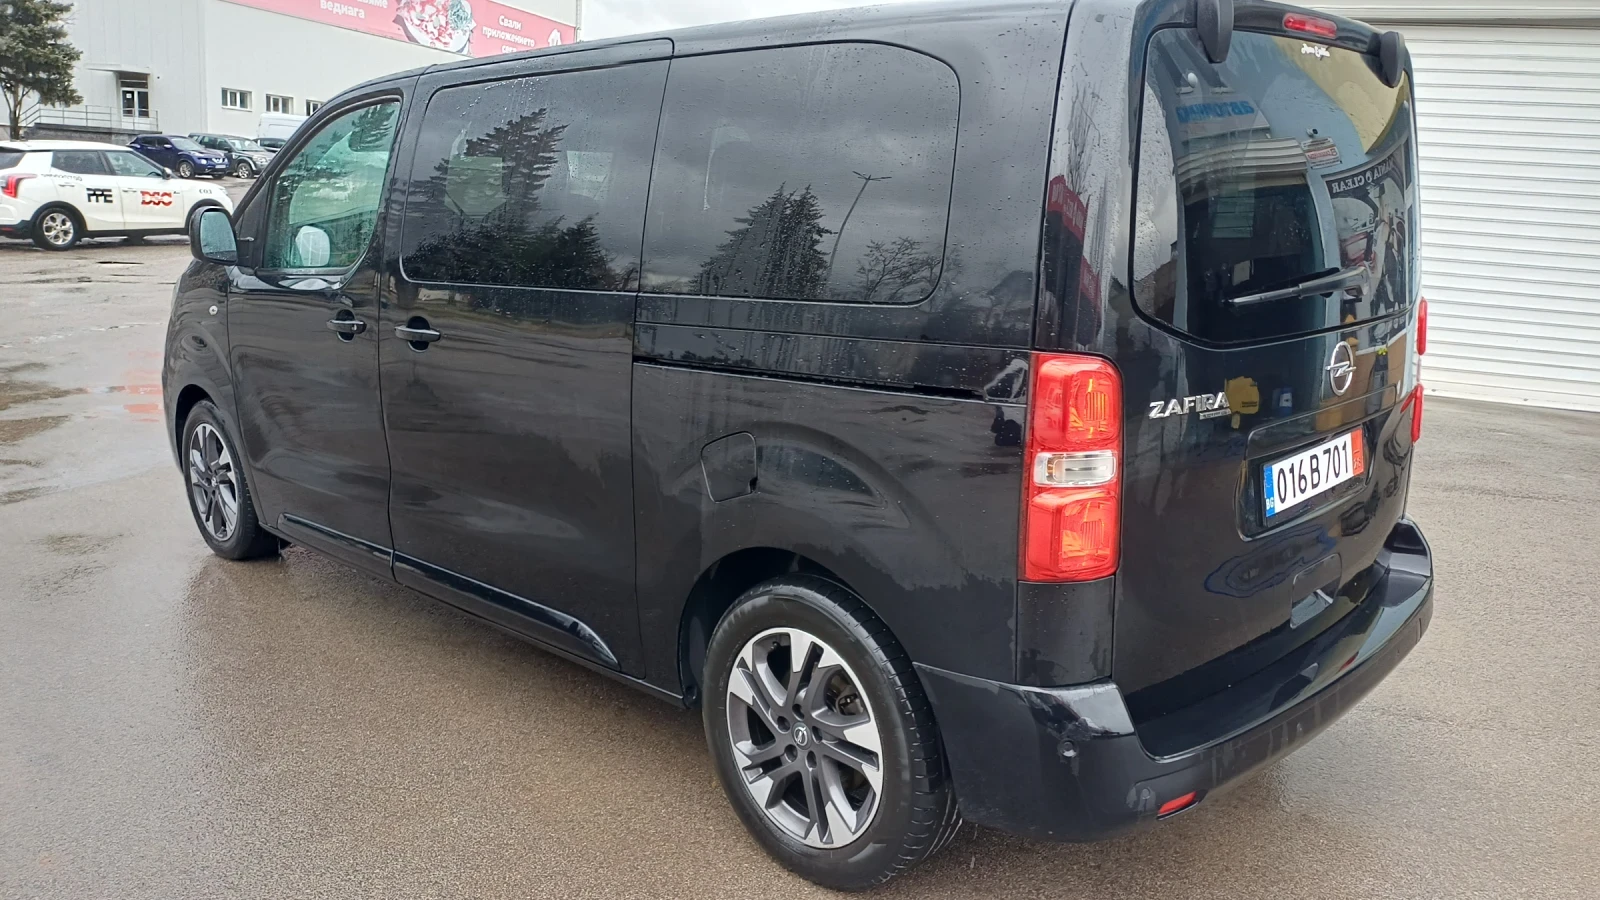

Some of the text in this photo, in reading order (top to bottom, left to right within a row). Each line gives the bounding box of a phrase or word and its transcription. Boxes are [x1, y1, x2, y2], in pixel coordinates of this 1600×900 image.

[320, 0, 365, 19] веднага
[498, 15, 522, 31] Свали
[482, 26, 535, 47] приложението
[1148, 391, 1230, 419] ZAFIRA
